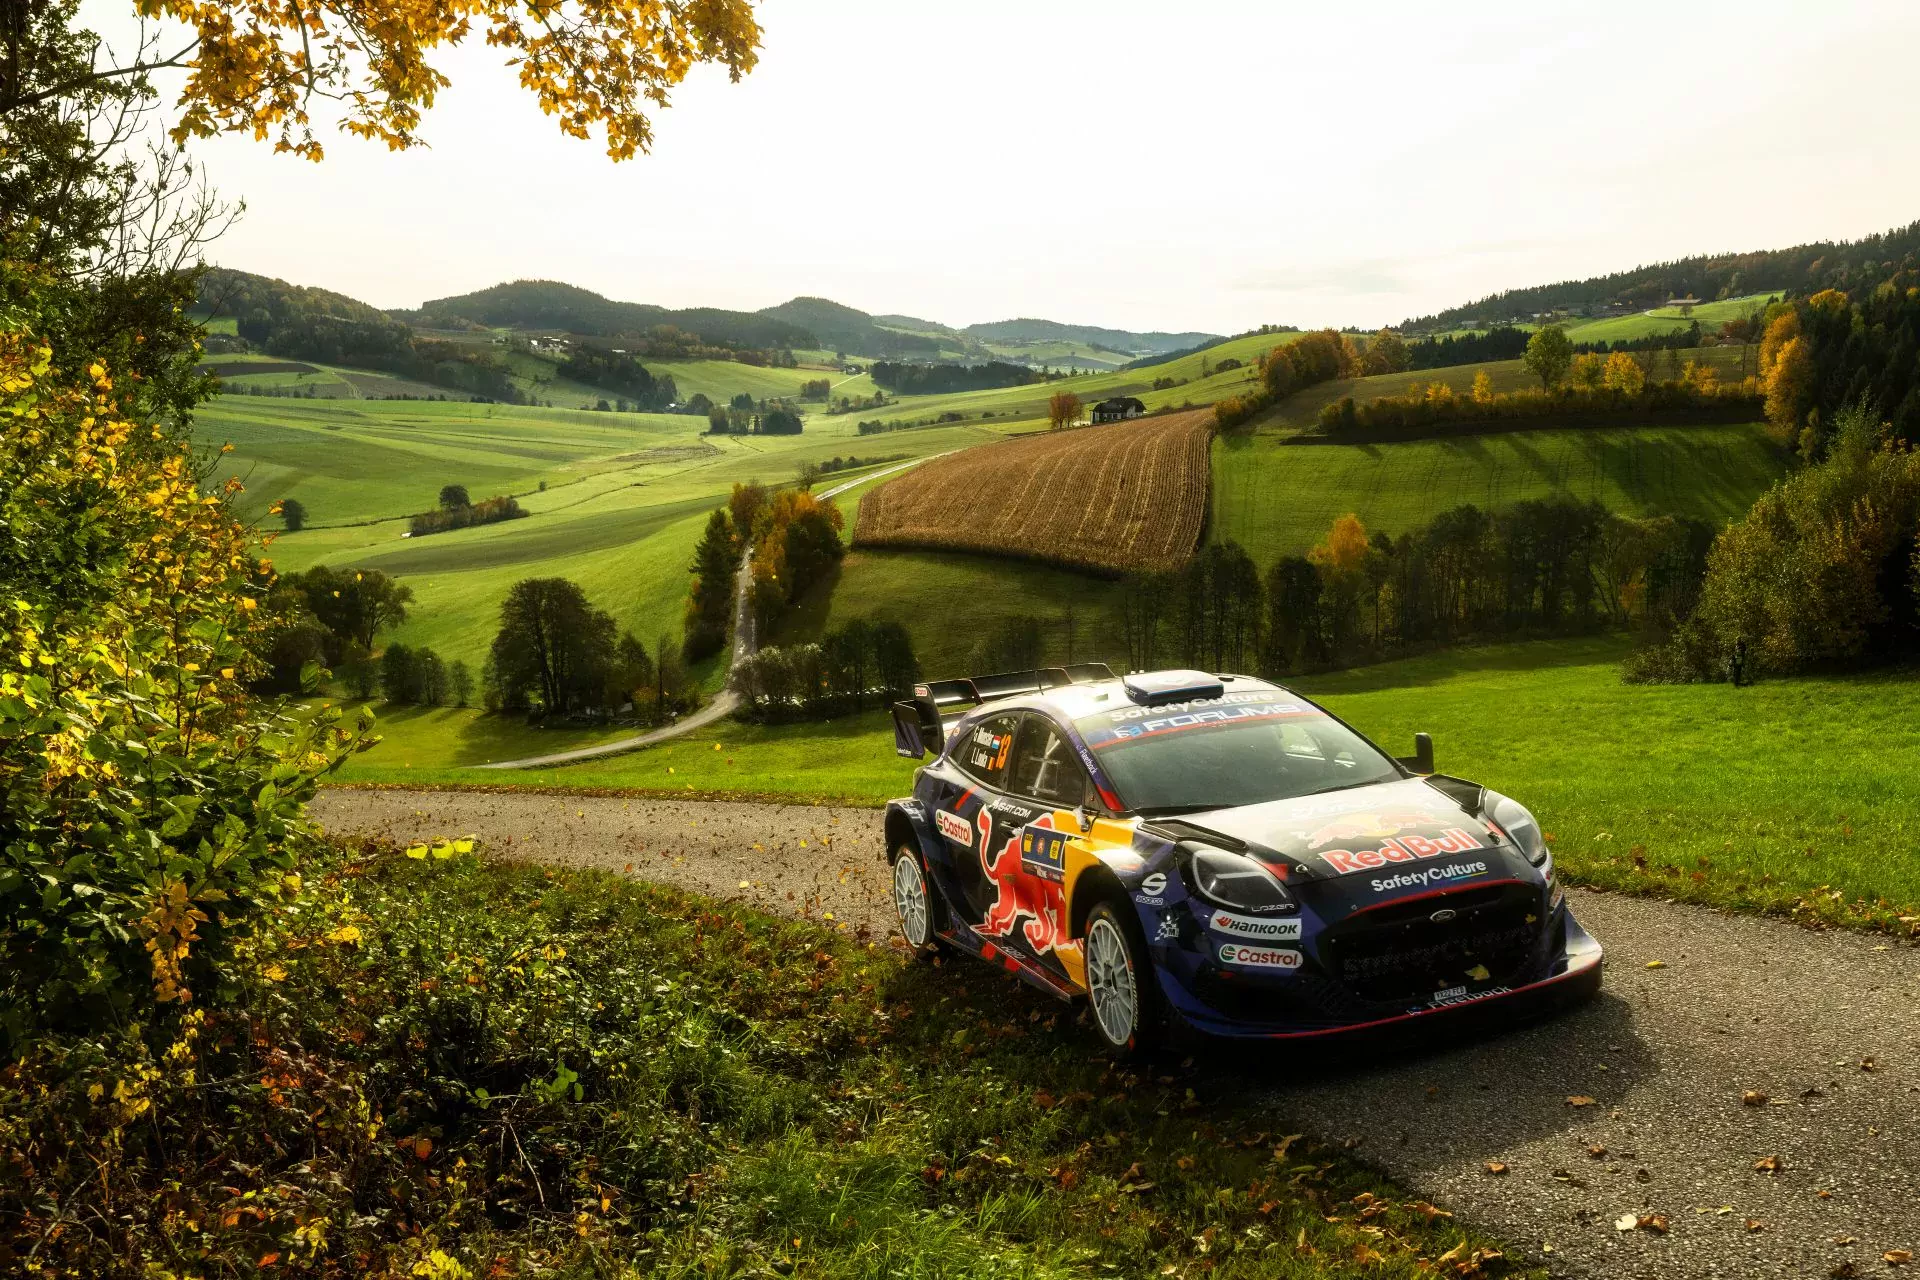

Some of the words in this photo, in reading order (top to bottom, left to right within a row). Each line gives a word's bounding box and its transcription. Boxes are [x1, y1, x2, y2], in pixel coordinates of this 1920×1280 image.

[943, 816, 971, 844] Castrol
[1371, 861, 1487, 892] SafetyCulture
[1237, 948, 1298, 965] Castrol
